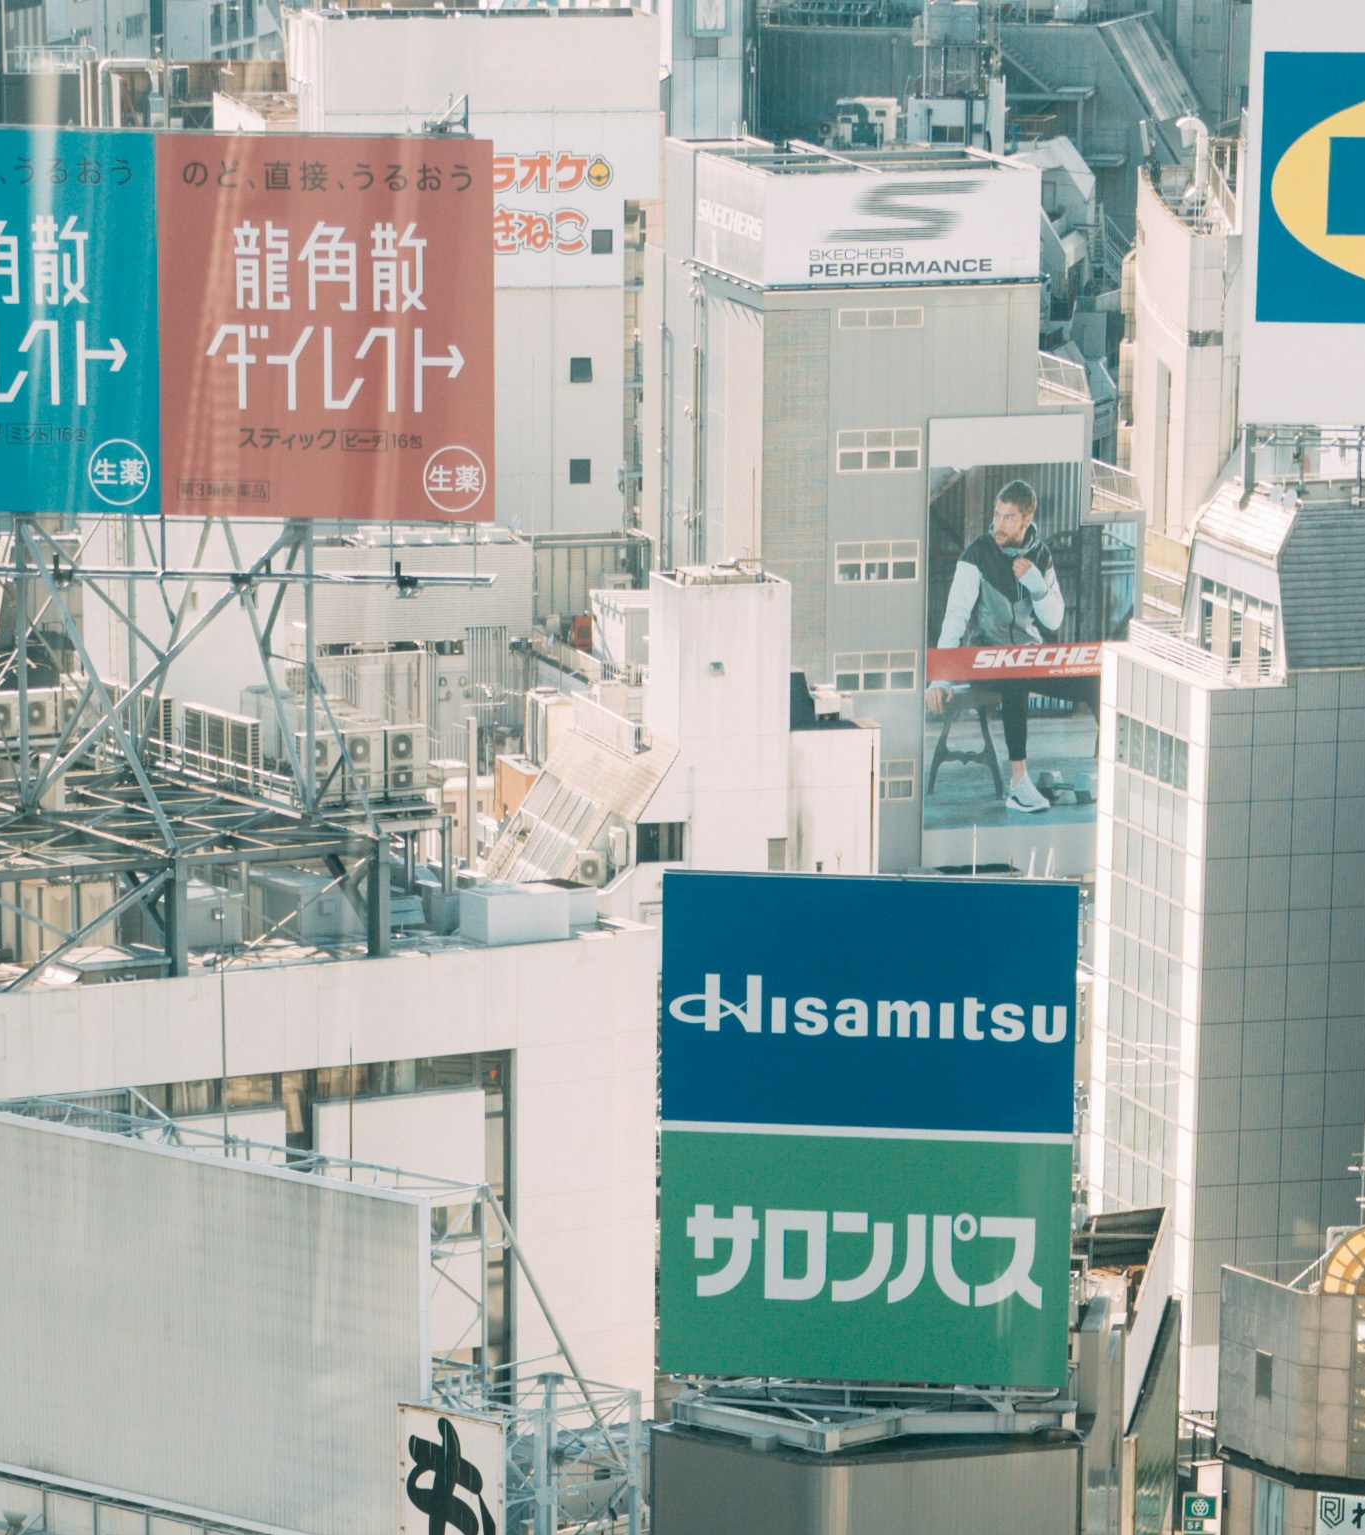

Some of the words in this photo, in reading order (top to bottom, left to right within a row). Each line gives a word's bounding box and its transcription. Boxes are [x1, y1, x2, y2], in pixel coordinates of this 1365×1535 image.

[182, 160, 473, 192] のど、直接、うるおう
[696, 199, 763, 242] SKECHERS
[234, 220, 428, 312] 龍角散
[808, 248, 904, 261] SKECHERS
[808, 259, 992, 278] PERFORMANCE
[238, 426, 338, 450] スティック
[91, 457, 148, 487] 生薬
[427, 465, 483, 494] 生薬
[669, 973, 1068, 1043] Hisamitsu
[686, 1204, 1043, 1309] サロンパス
